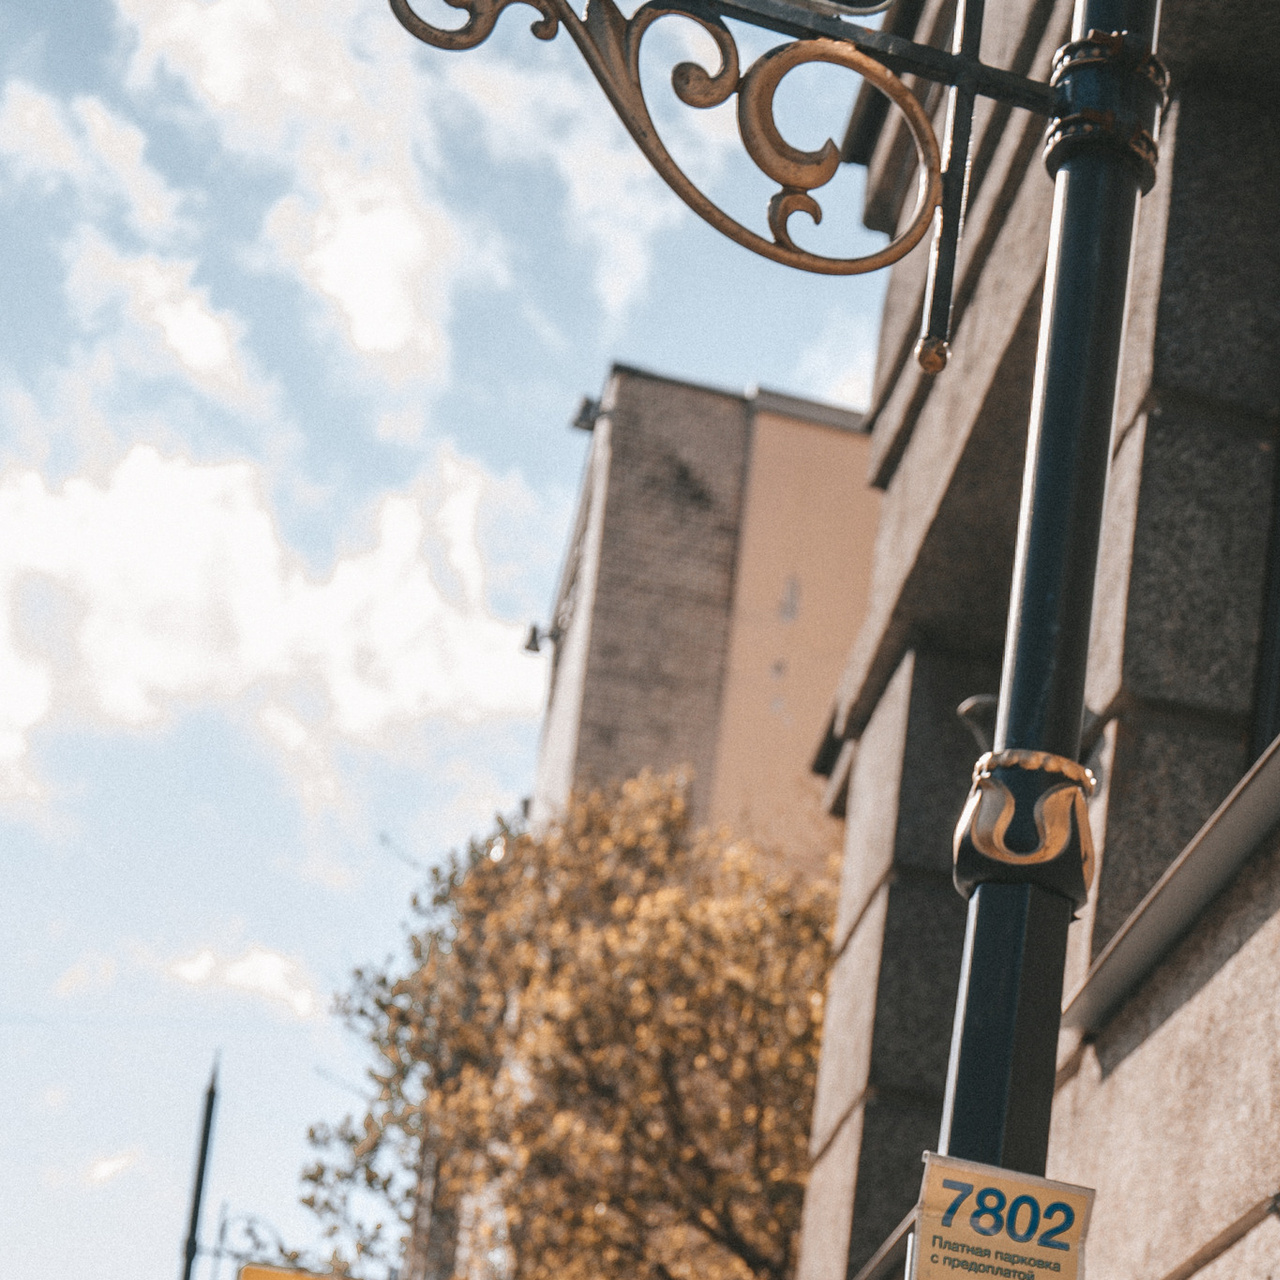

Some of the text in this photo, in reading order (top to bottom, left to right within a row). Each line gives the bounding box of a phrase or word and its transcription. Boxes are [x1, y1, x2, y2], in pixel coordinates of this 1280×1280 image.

[941, 1178, 1076, 1252] 7802
[930, 1253, 939, 1264] с
[931, 1234, 1061, 1273] Платная парковка
